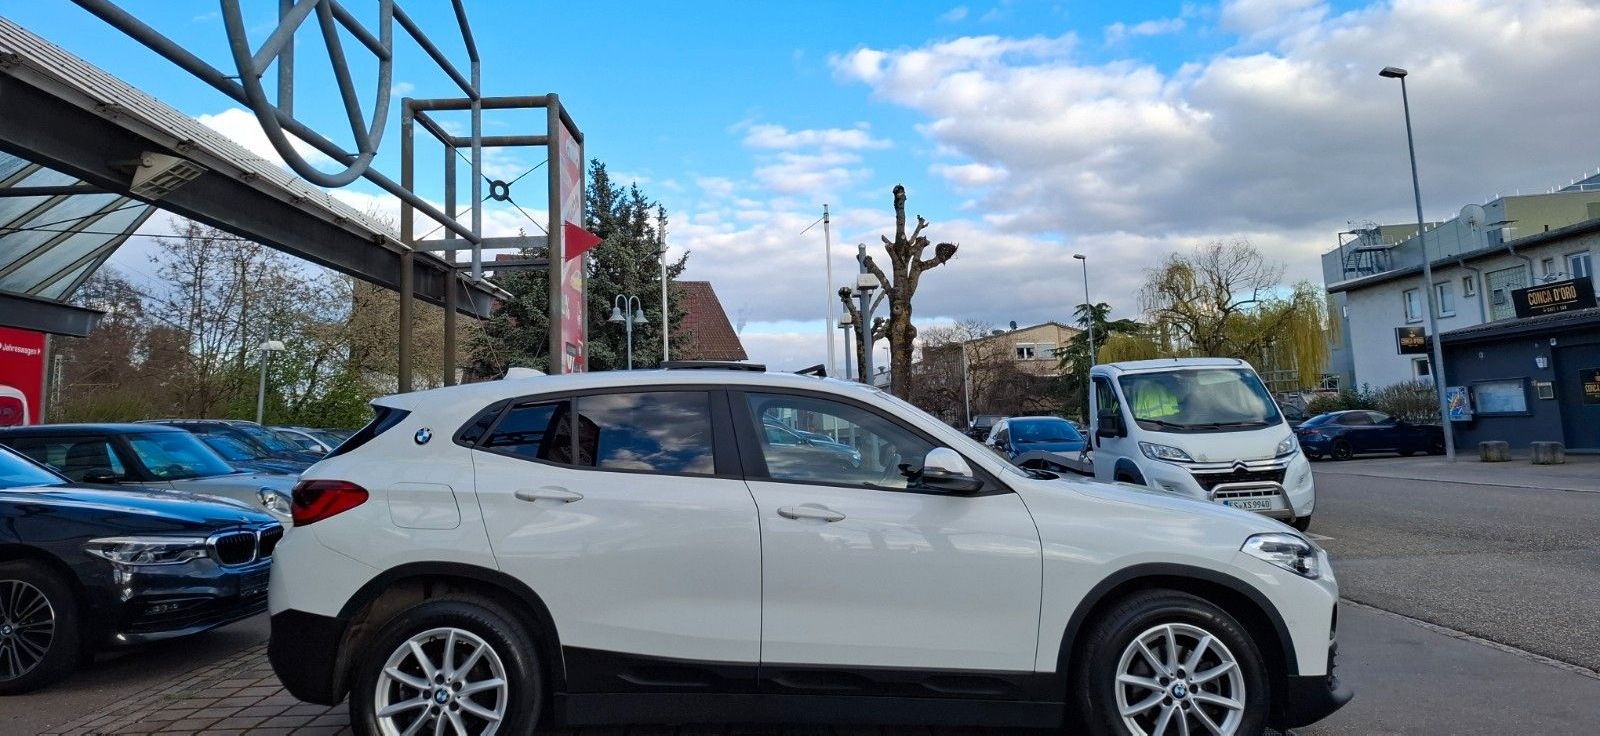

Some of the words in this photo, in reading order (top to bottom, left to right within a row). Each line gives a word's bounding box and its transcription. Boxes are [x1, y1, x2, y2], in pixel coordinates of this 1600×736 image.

[1527, 289, 1553, 306] CONCA
[1553, 285, 1577, 302] D'ORO
[2, 343, 37, 356] Jahreswagen
